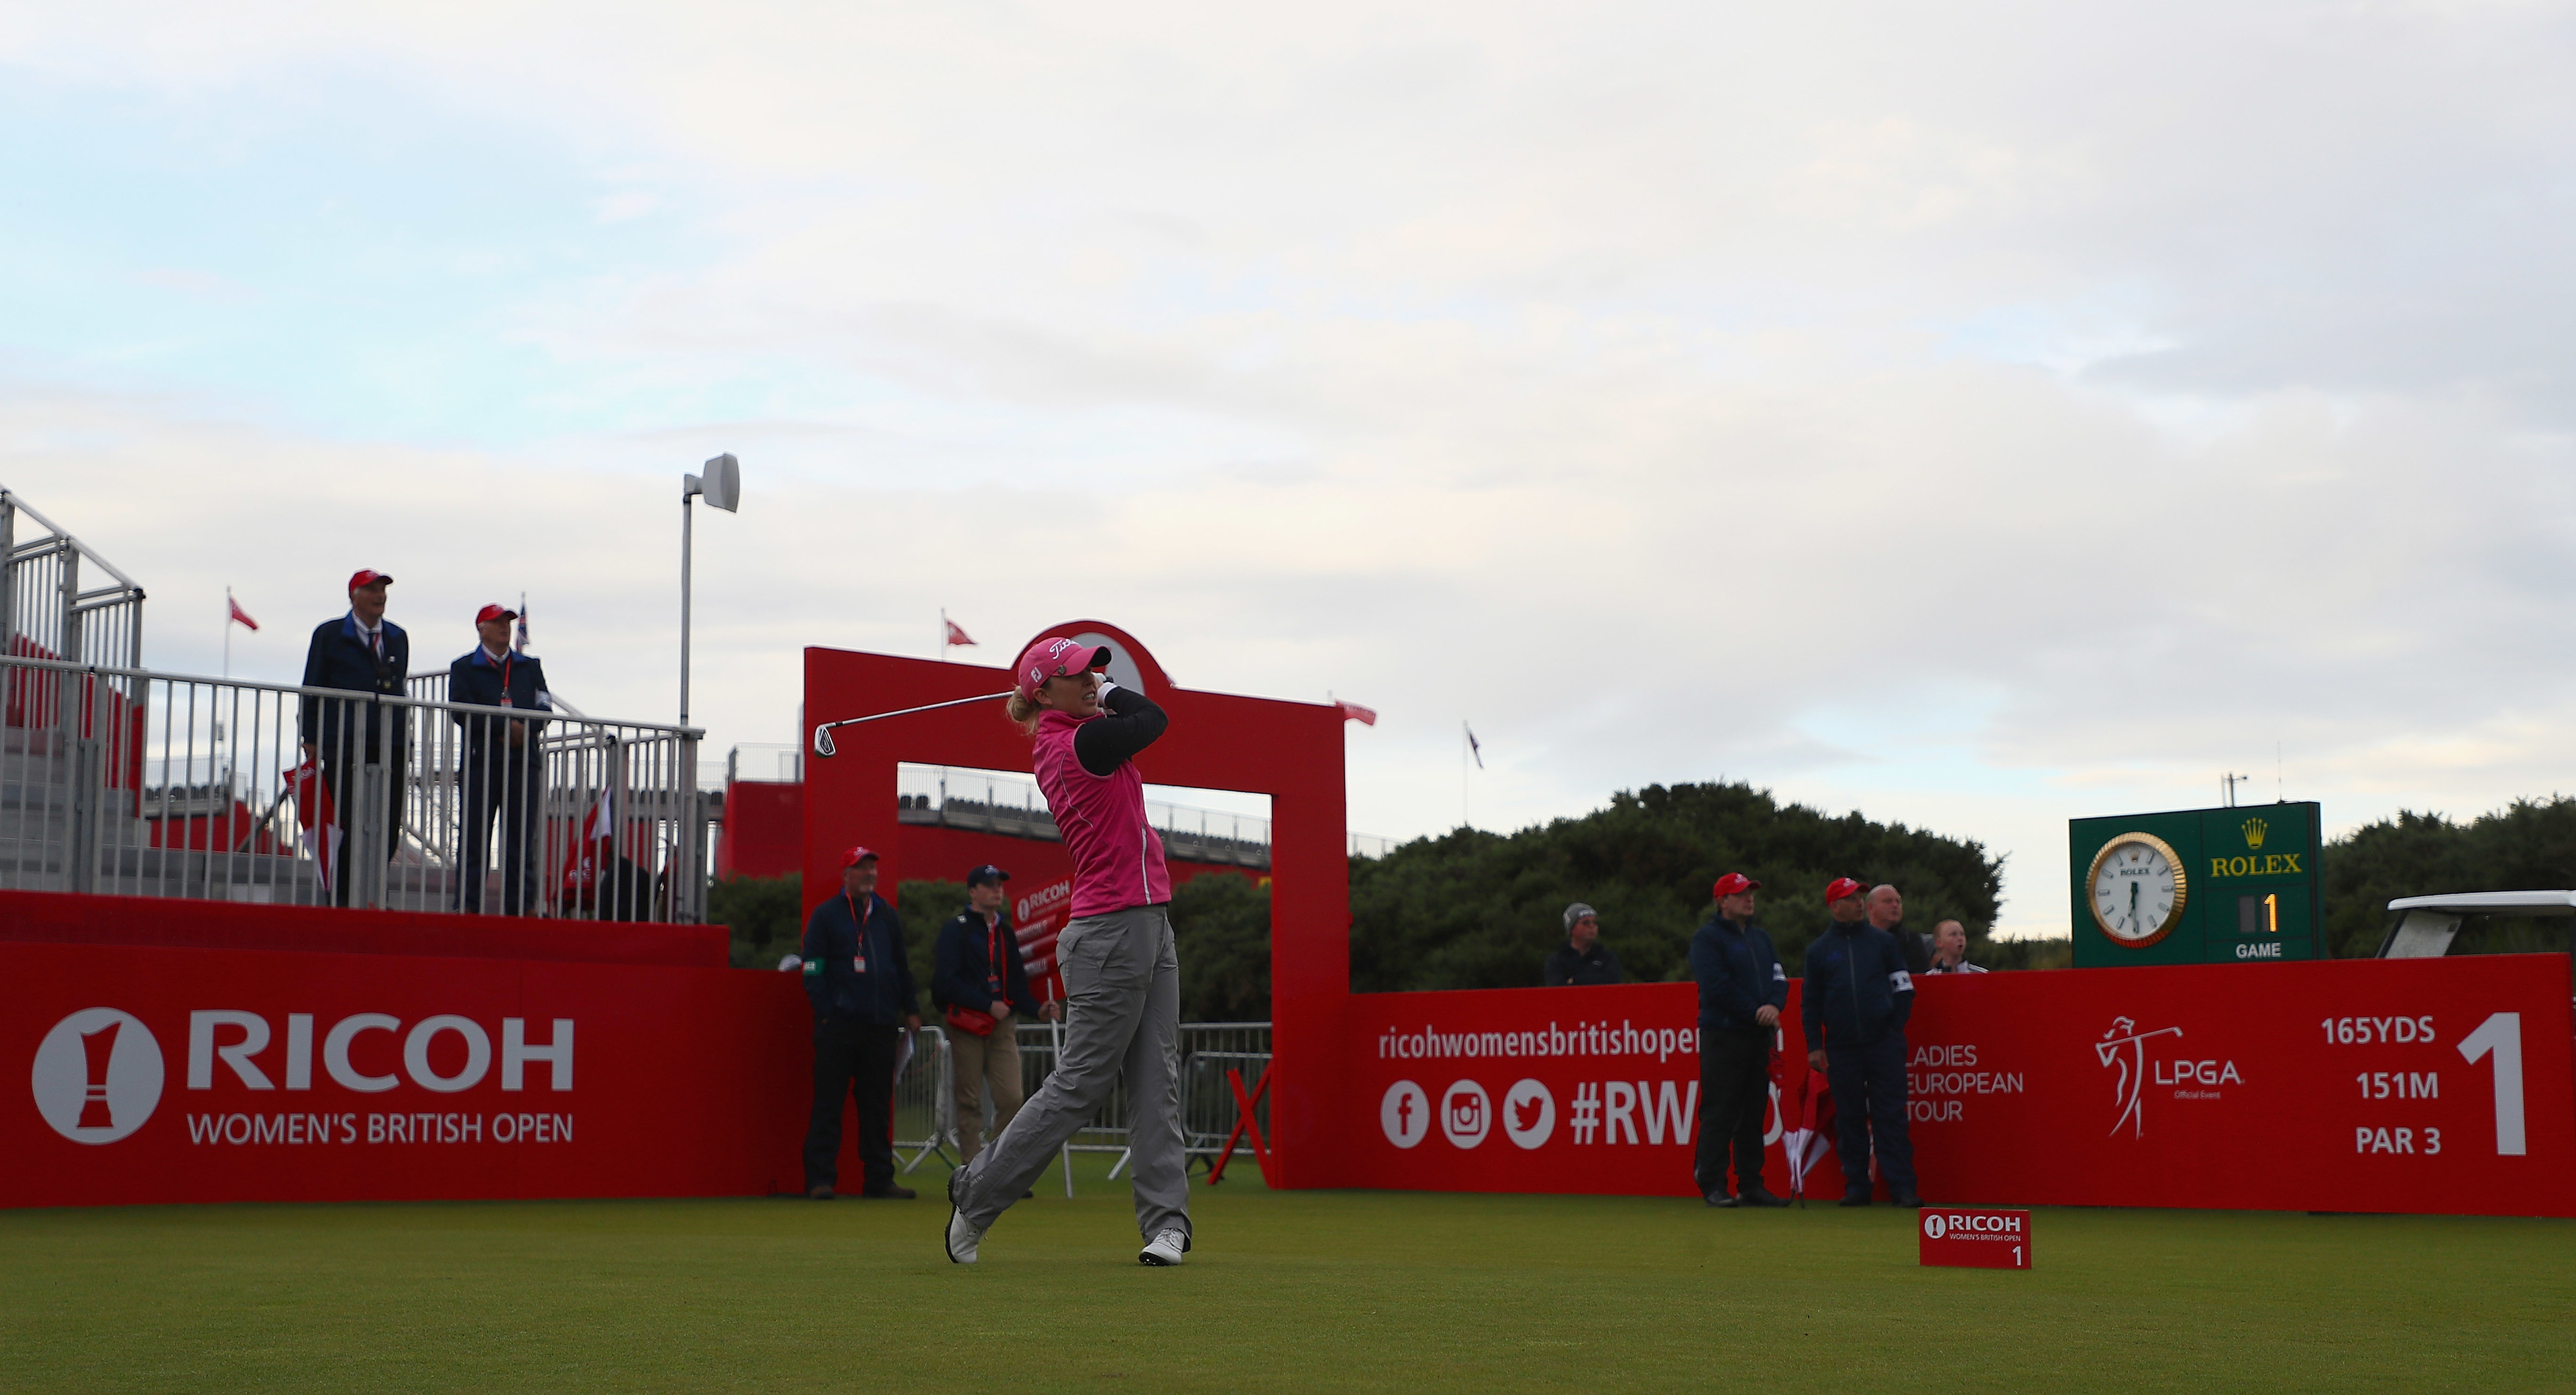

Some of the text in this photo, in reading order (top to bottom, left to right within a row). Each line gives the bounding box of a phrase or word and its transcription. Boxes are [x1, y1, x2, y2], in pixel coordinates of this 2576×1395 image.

[2120, 867, 2150, 877] ROLEX
[2210, 853, 2302, 877] ROLEX
[1029, 879, 1071, 909] RICOH
[2263, 893, 2277, 932] 1
[2235, 942, 2282, 959] GAME
[2321, 1015, 2436, 1045] 165YDS
[187, 1009, 574, 1093] RICOH
[2155, 1060, 2242, 1085] LPGA
[2457, 1011, 2526, 1156] 1
[2174, 1089, 2221, 1100] Official Event
[2356, 1072, 2439, 1100] 151M
[1905, 1100, 1964, 1123] TOUR
[186, 1113, 574, 1146] WOMEN'S BRITISH OPEN
[2356, 1127, 2441, 1155] PAR 3
[1948, 1215, 2021, 1233] RICOH
[1949, 1233, 1980, 1241] WOMEN'S
[1980, 1234, 2003, 1242] BRITISH
[2012, 1245, 2022, 1267] 1
